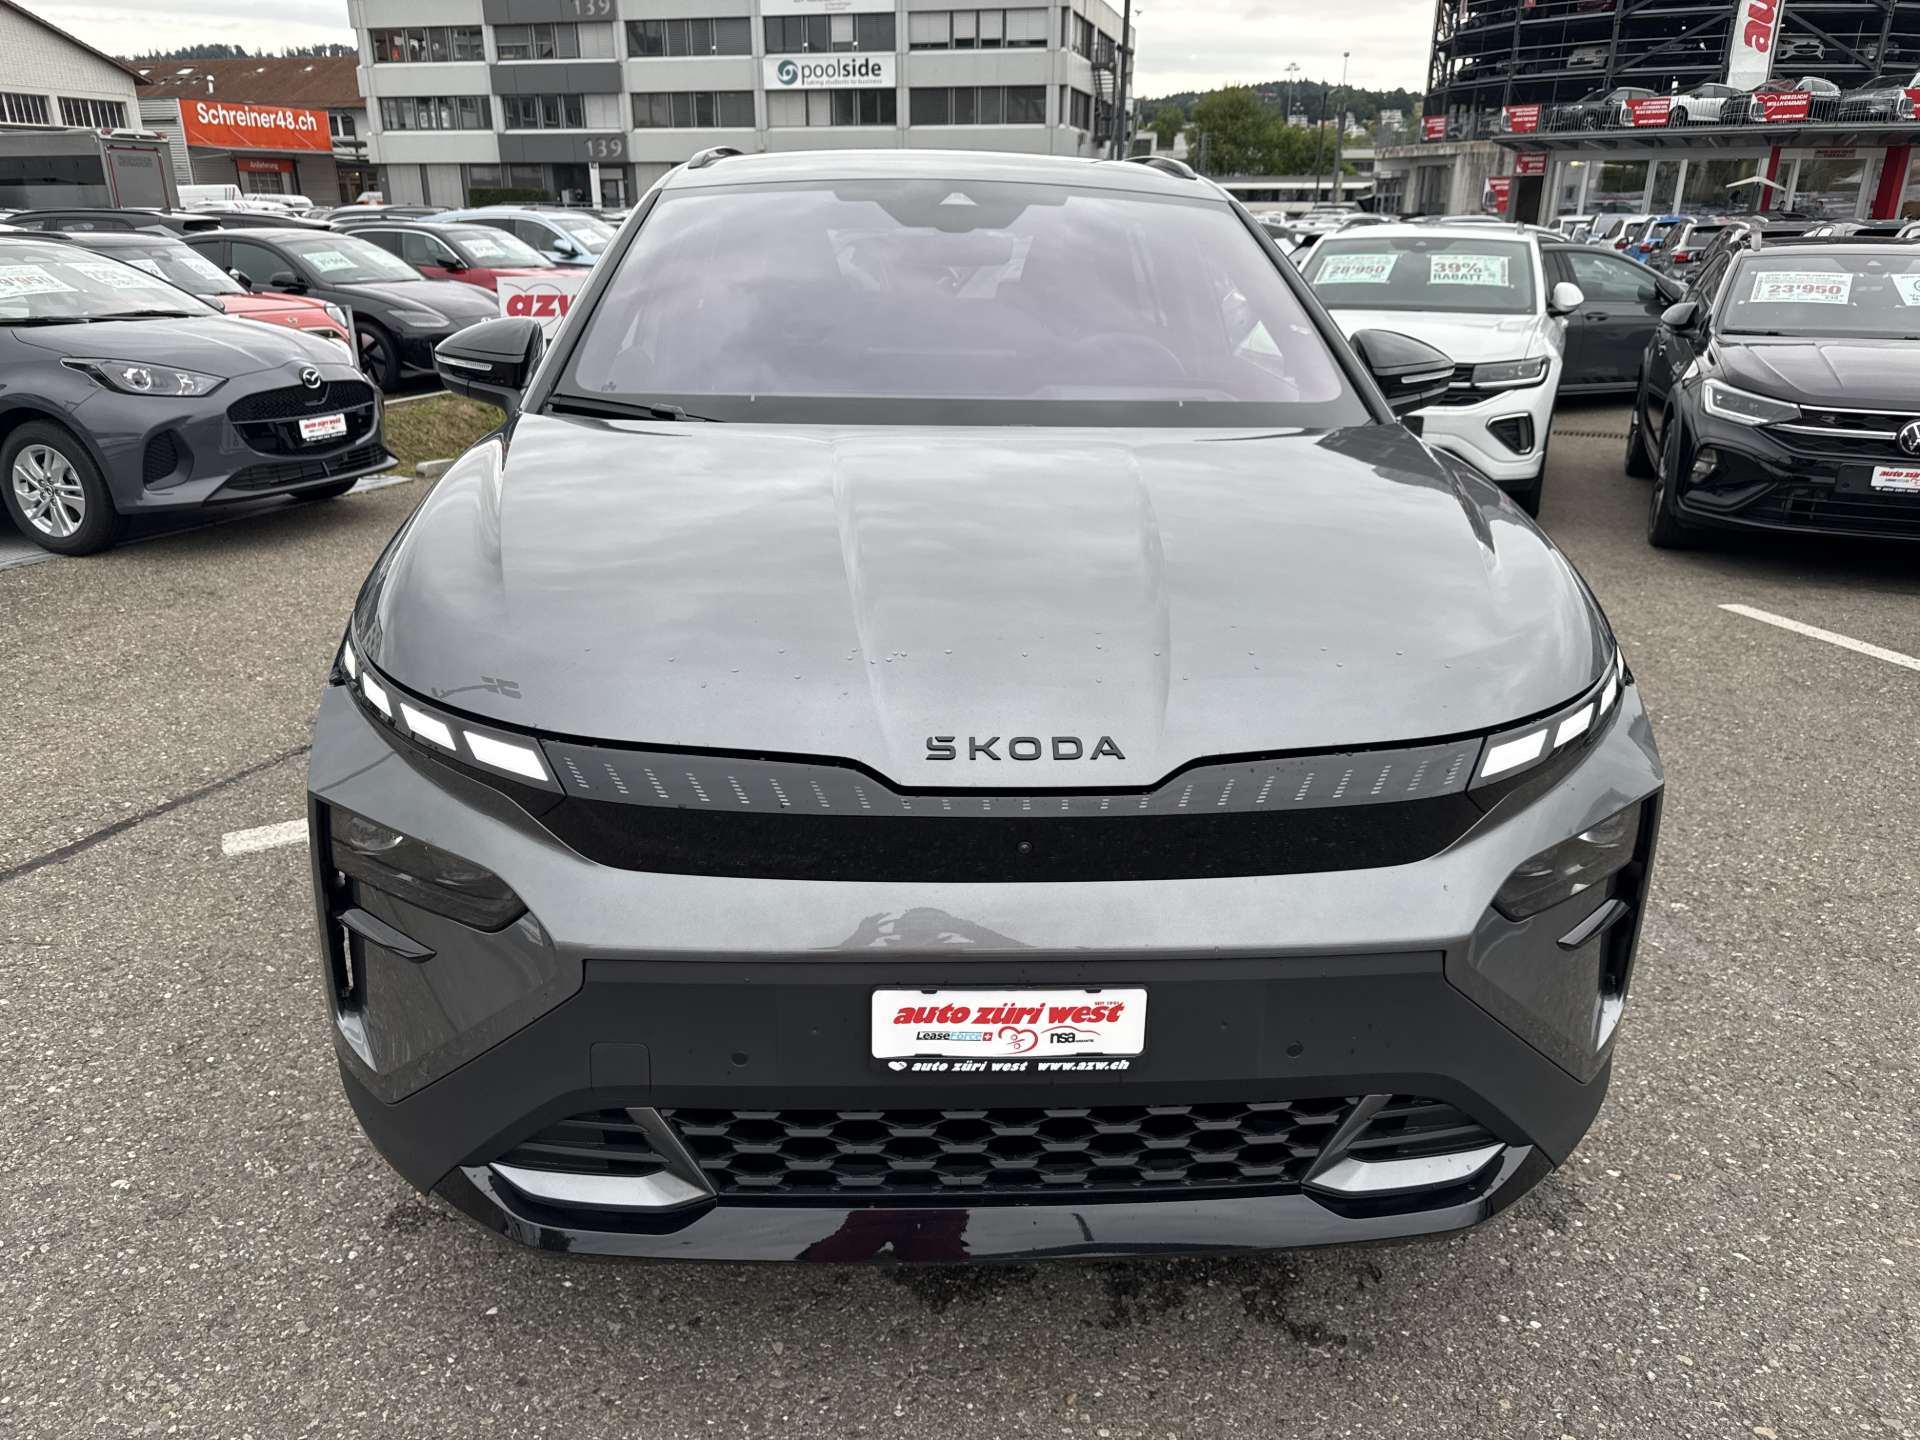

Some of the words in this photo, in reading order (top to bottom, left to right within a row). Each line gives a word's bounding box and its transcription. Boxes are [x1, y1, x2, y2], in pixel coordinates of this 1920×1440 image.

[801, 57, 882, 86] poolside
[196, 102, 318, 132] Schreiner48.ch
[585, 138, 623, 158] 139
[1433, 262, 1482, 273] 39%
[1433, 273, 1482, 281] RABATT
[1767, 284, 1842, 295] 23'950
[925, 736, 1126, 761] SKODA
[893, 1002, 971, 1024] auto
[971, 1002, 1046, 1025] züri
[1048, 1002, 1125, 1024] west
[1050, 1032, 1076, 1044] nsa
[911, 1061, 949, 1072] auto
[951, 1060, 988, 1072] züri
[991, 1061, 1028, 1072] west
[1037, 1059, 1130, 1072] www.azw.ch
